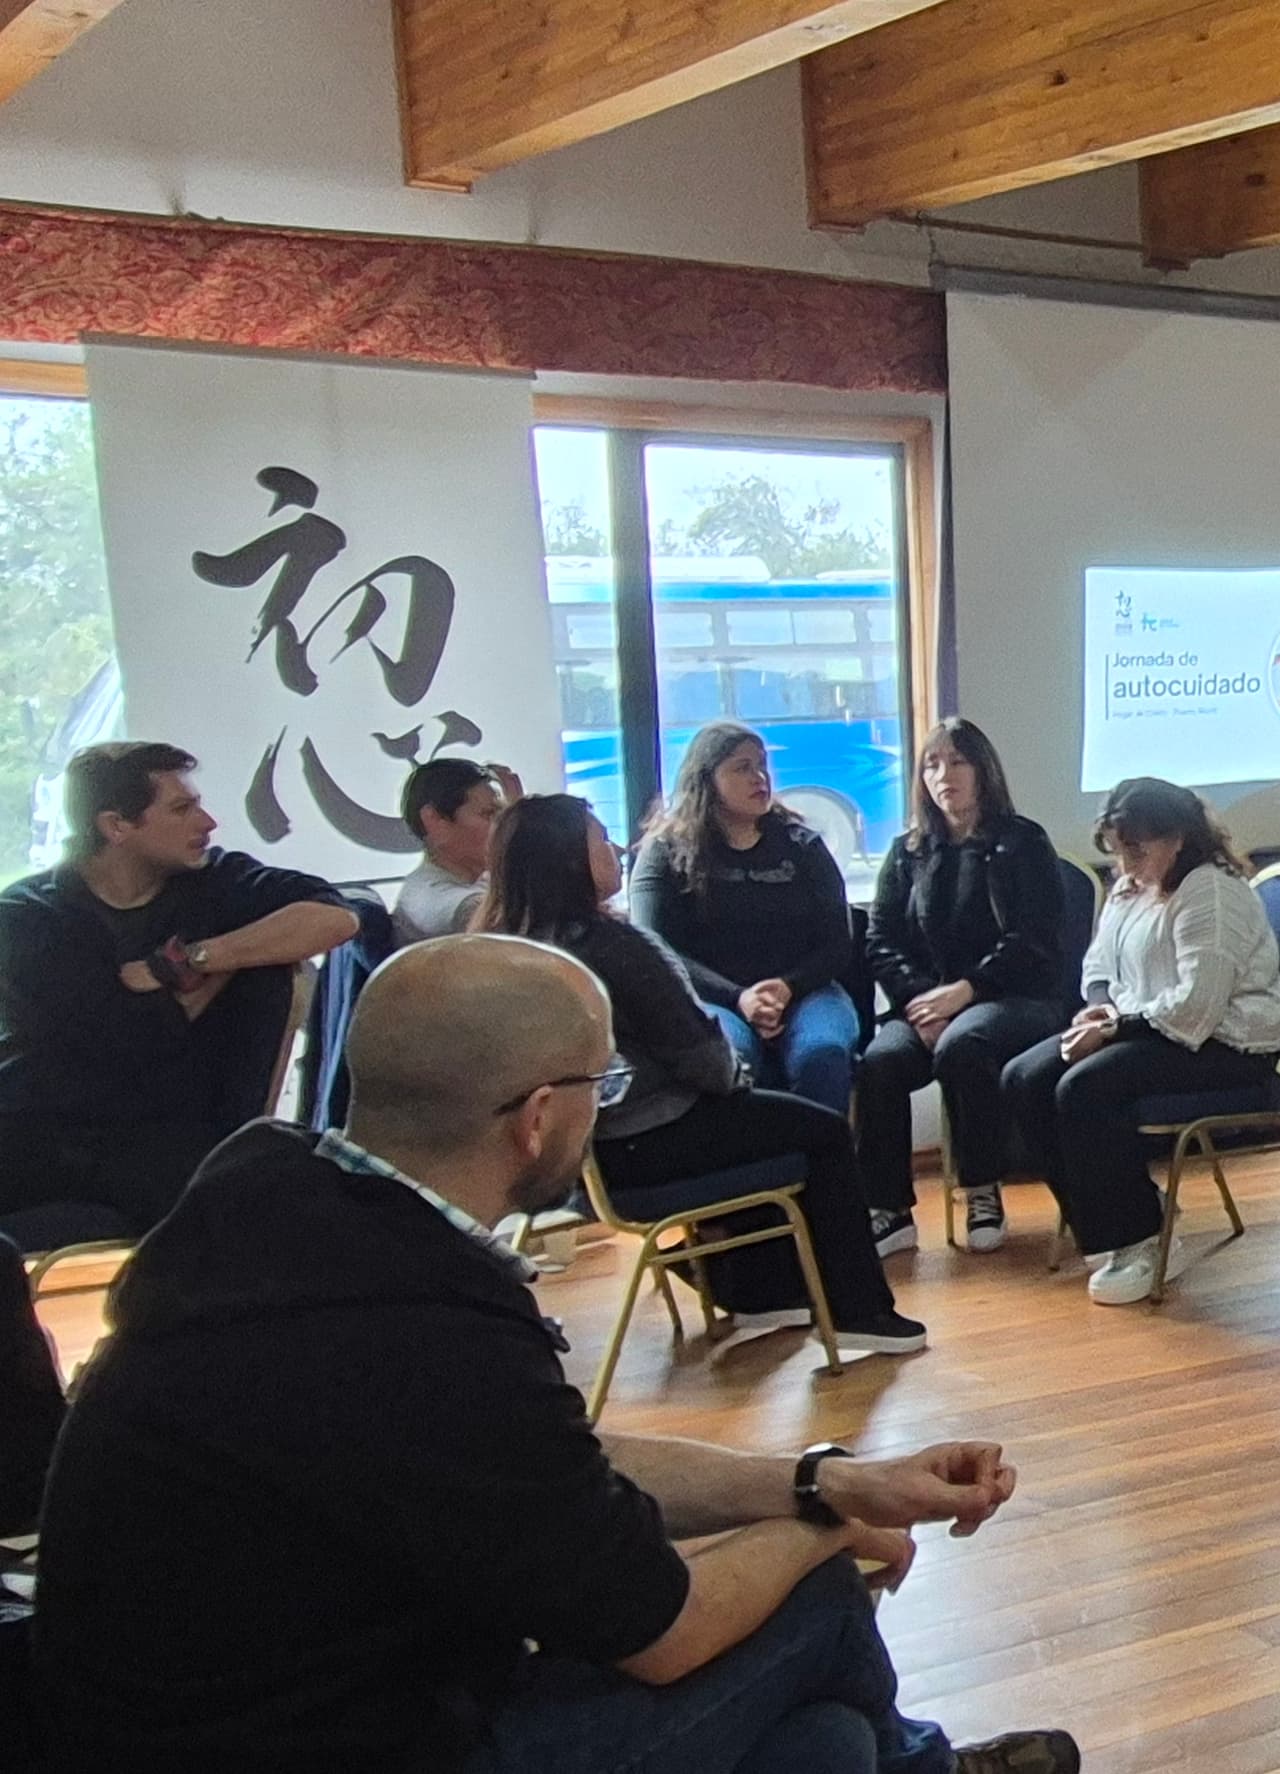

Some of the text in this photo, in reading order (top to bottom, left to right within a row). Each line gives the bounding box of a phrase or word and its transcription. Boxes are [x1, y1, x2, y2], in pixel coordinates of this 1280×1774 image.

[192, 466, 482, 853] 初心
[1113, 651, 1199, 668] Jornada de
[1113, 672, 1261, 698] autocuidado
